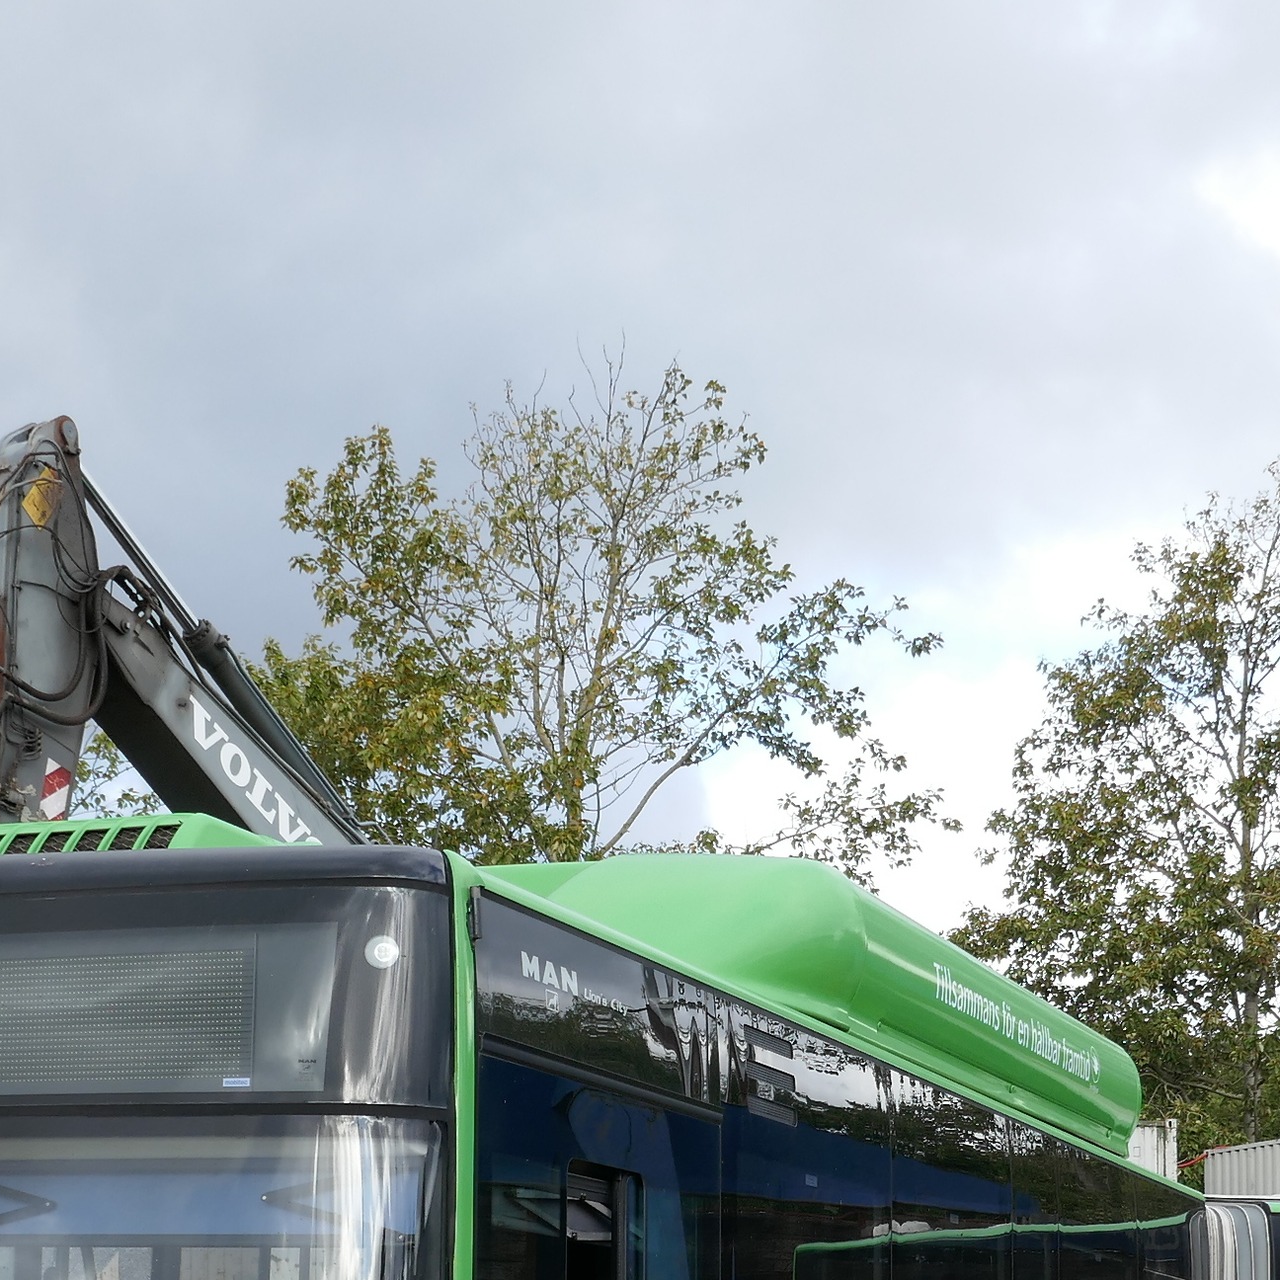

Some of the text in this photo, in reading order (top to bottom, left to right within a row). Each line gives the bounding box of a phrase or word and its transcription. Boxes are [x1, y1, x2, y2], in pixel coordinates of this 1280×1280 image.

[189, 694, 323, 845] VOLV
[521, 950, 579, 997] MAN
[584, 987, 629, 1017] Lion's City
[933, 962, 1091, 1081] Tillsammans för en hållbar framtid
